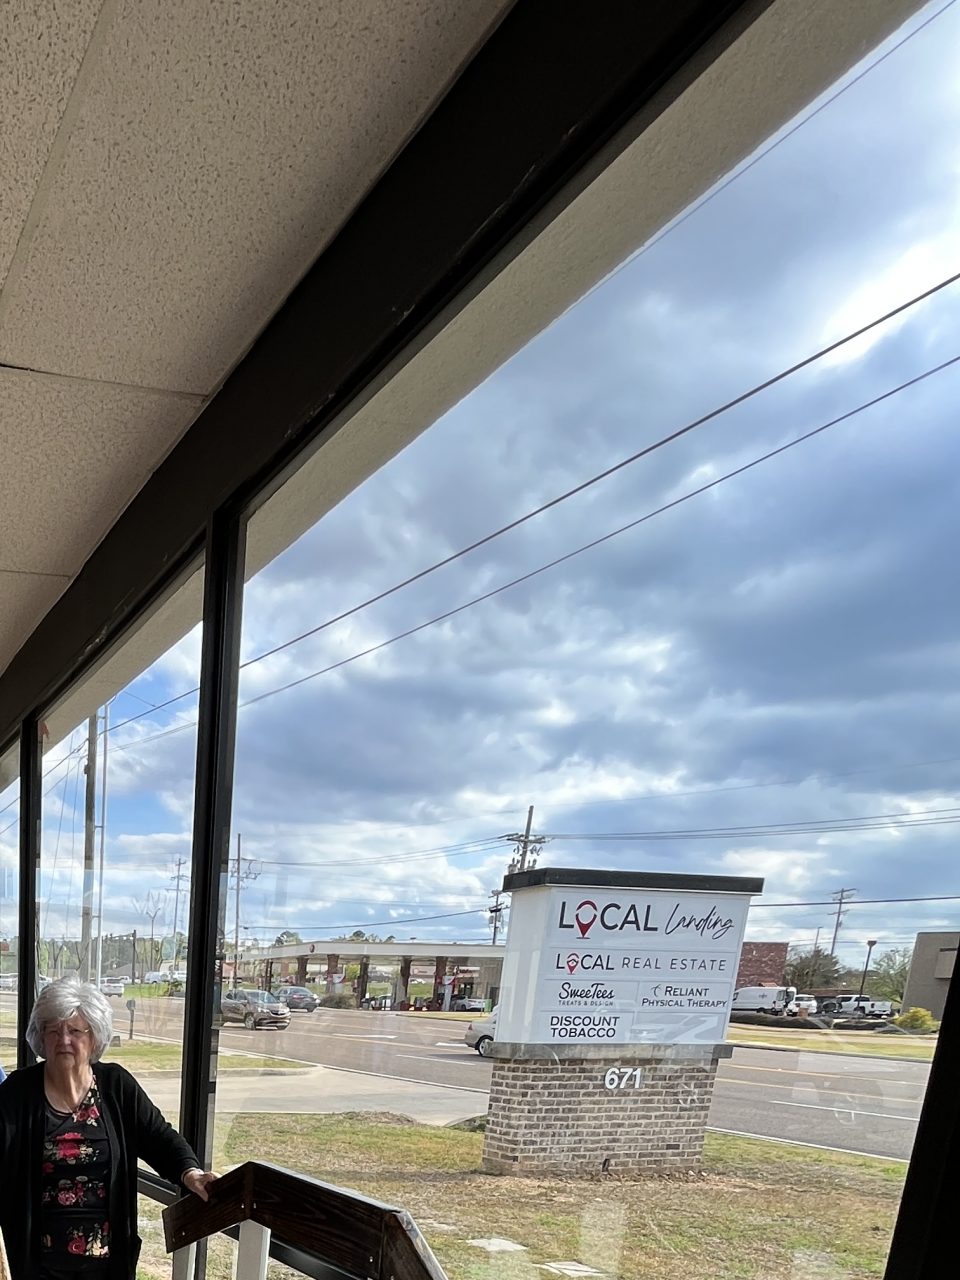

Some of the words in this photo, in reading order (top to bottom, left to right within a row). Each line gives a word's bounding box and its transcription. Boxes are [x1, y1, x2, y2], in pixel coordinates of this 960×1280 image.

[558, 900, 658, 939] LOCAL
[556, 953, 615, 975] LOCAL
[621, 957, 662, 969] REAL
[670, 958, 727, 971] ESTATE
[550, 1016, 620, 1027] DISCOUNT
[551, 1027, 616, 1038] TOBACCO
[604, 1067, 642, 1089] 671
